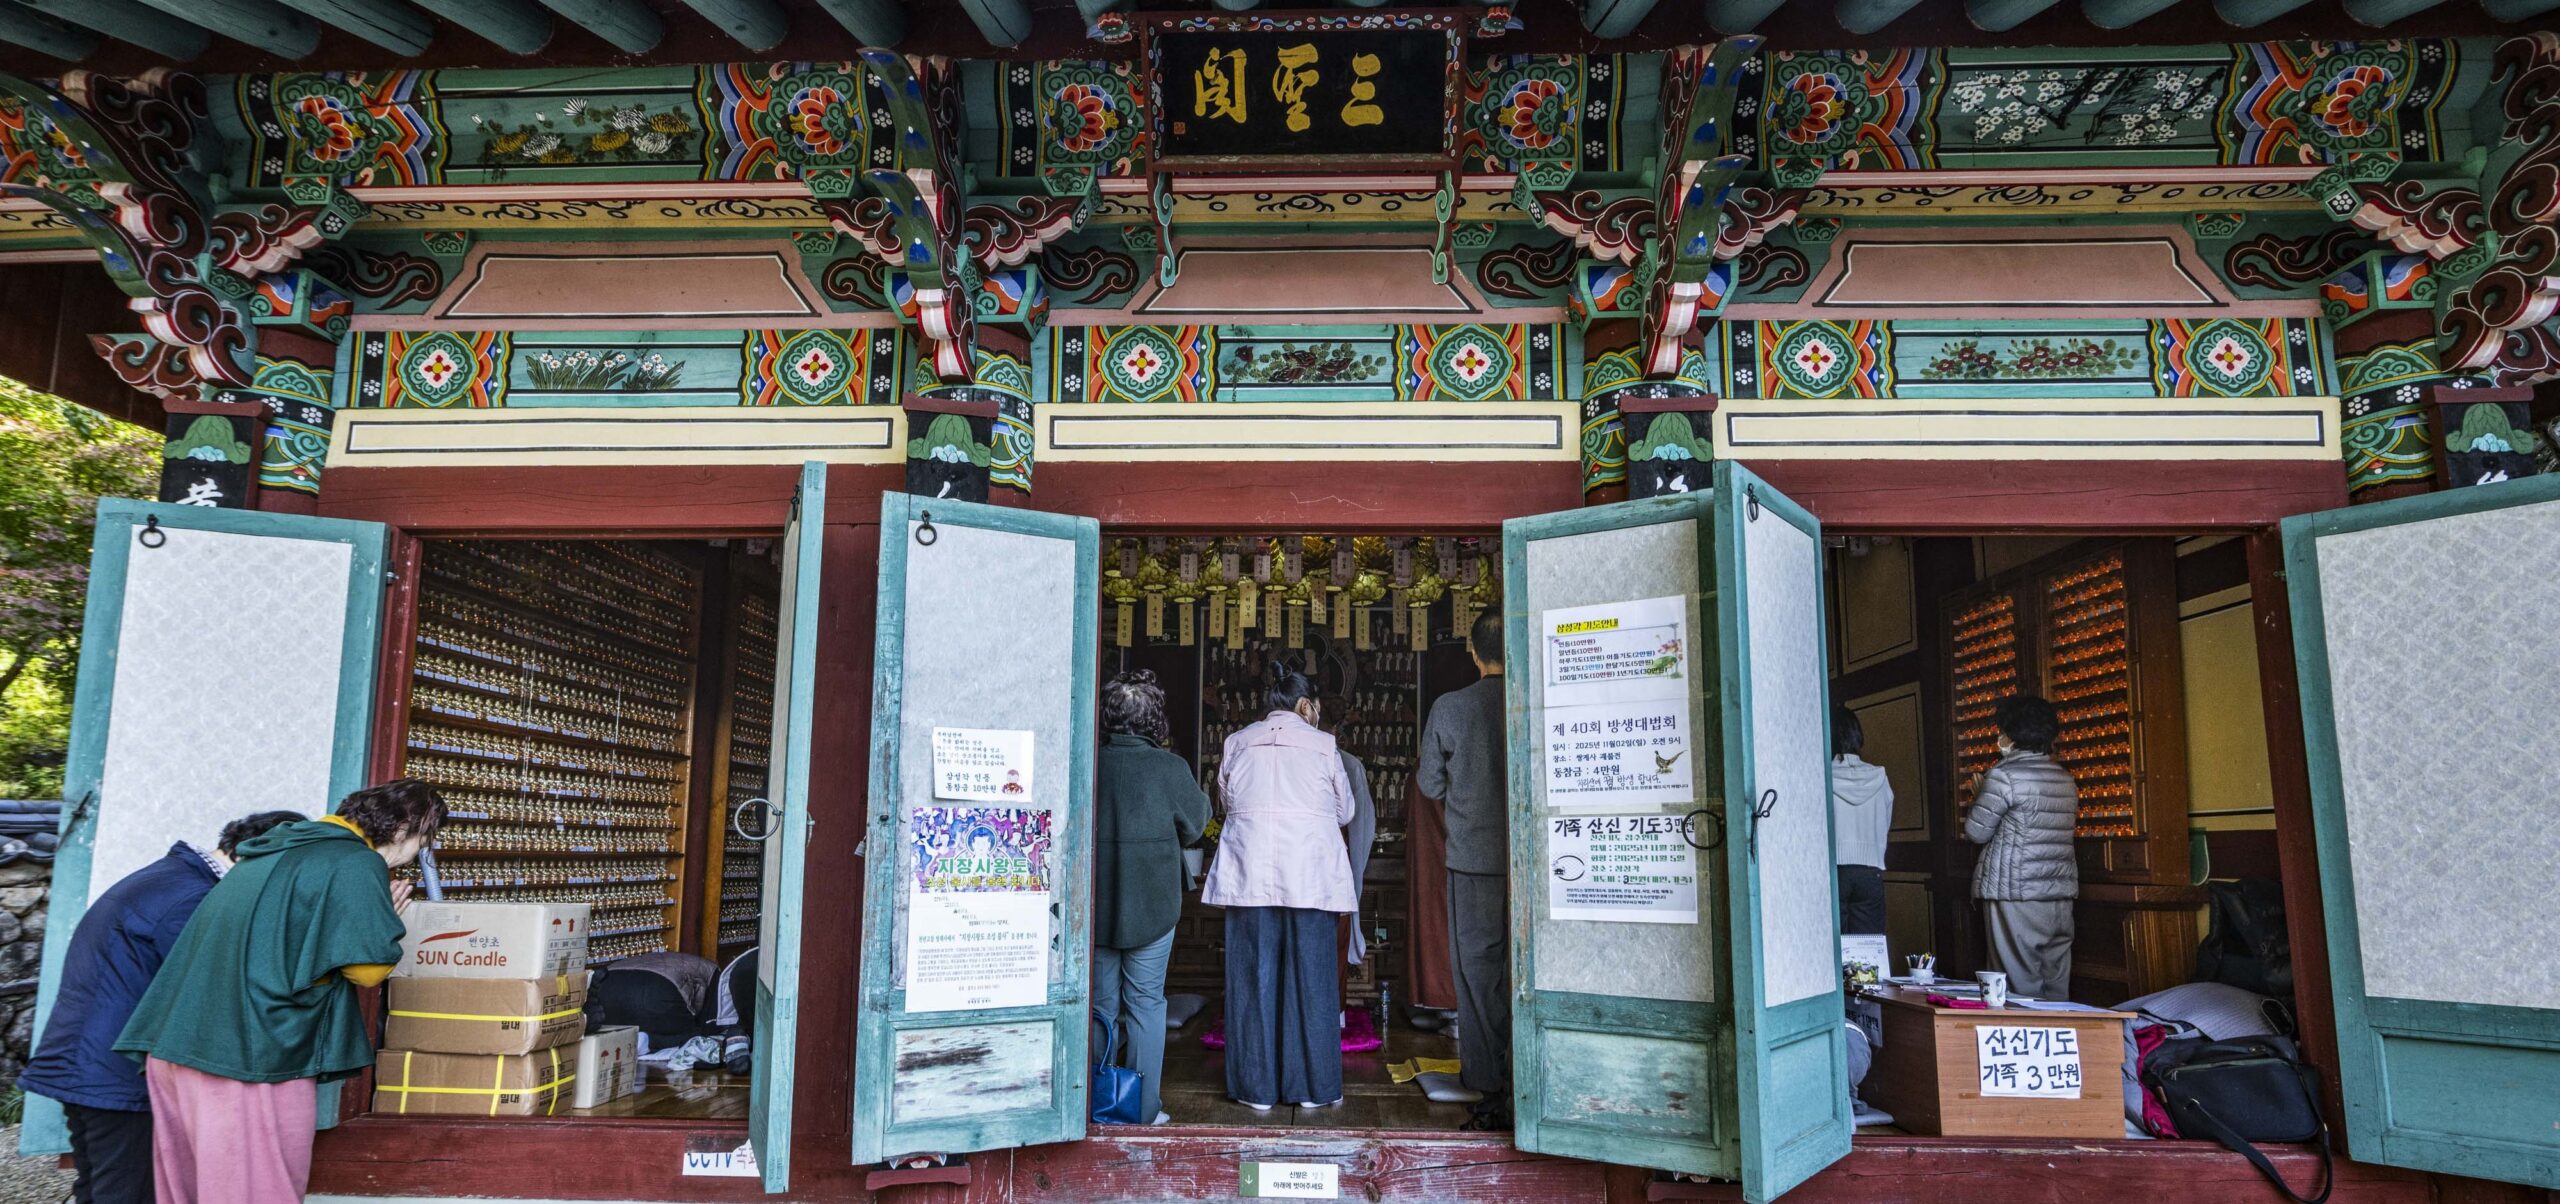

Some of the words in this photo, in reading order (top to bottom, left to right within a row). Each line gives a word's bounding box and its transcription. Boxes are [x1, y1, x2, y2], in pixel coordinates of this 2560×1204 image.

[1552, 723, 1565, 736] 제
[1570, 720, 1601, 734] 40회
[1607, 715, 1676, 733] 방생대법회
[1575, 741, 1600, 750] 2025년
[1651, 737, 1666, 746] 오전
[1668, 736, 1681, 745] 9시
[1553, 766, 1583, 778] 동참금
[1593, 765, 1620, 776] 4만원
[1617, 774, 1634, 786] 방생
[973, 784, 997, 793] 10만원
[1554, 818, 1582, 837] 가족
[938, 858, 1028, 874] 지장시왕도
[416, 951, 449, 966] SUN
[453, 951, 507, 967] Candle
[1985, 1028, 2077, 1057] 산신기도
[1983, 1063, 2019, 1088] 가족
[1289, 1171, 1308, 1179] 신발은
[1273, 1181, 1292, 1189] 아래에
[1293, 1182, 1324, 1190] 벗어주세요
